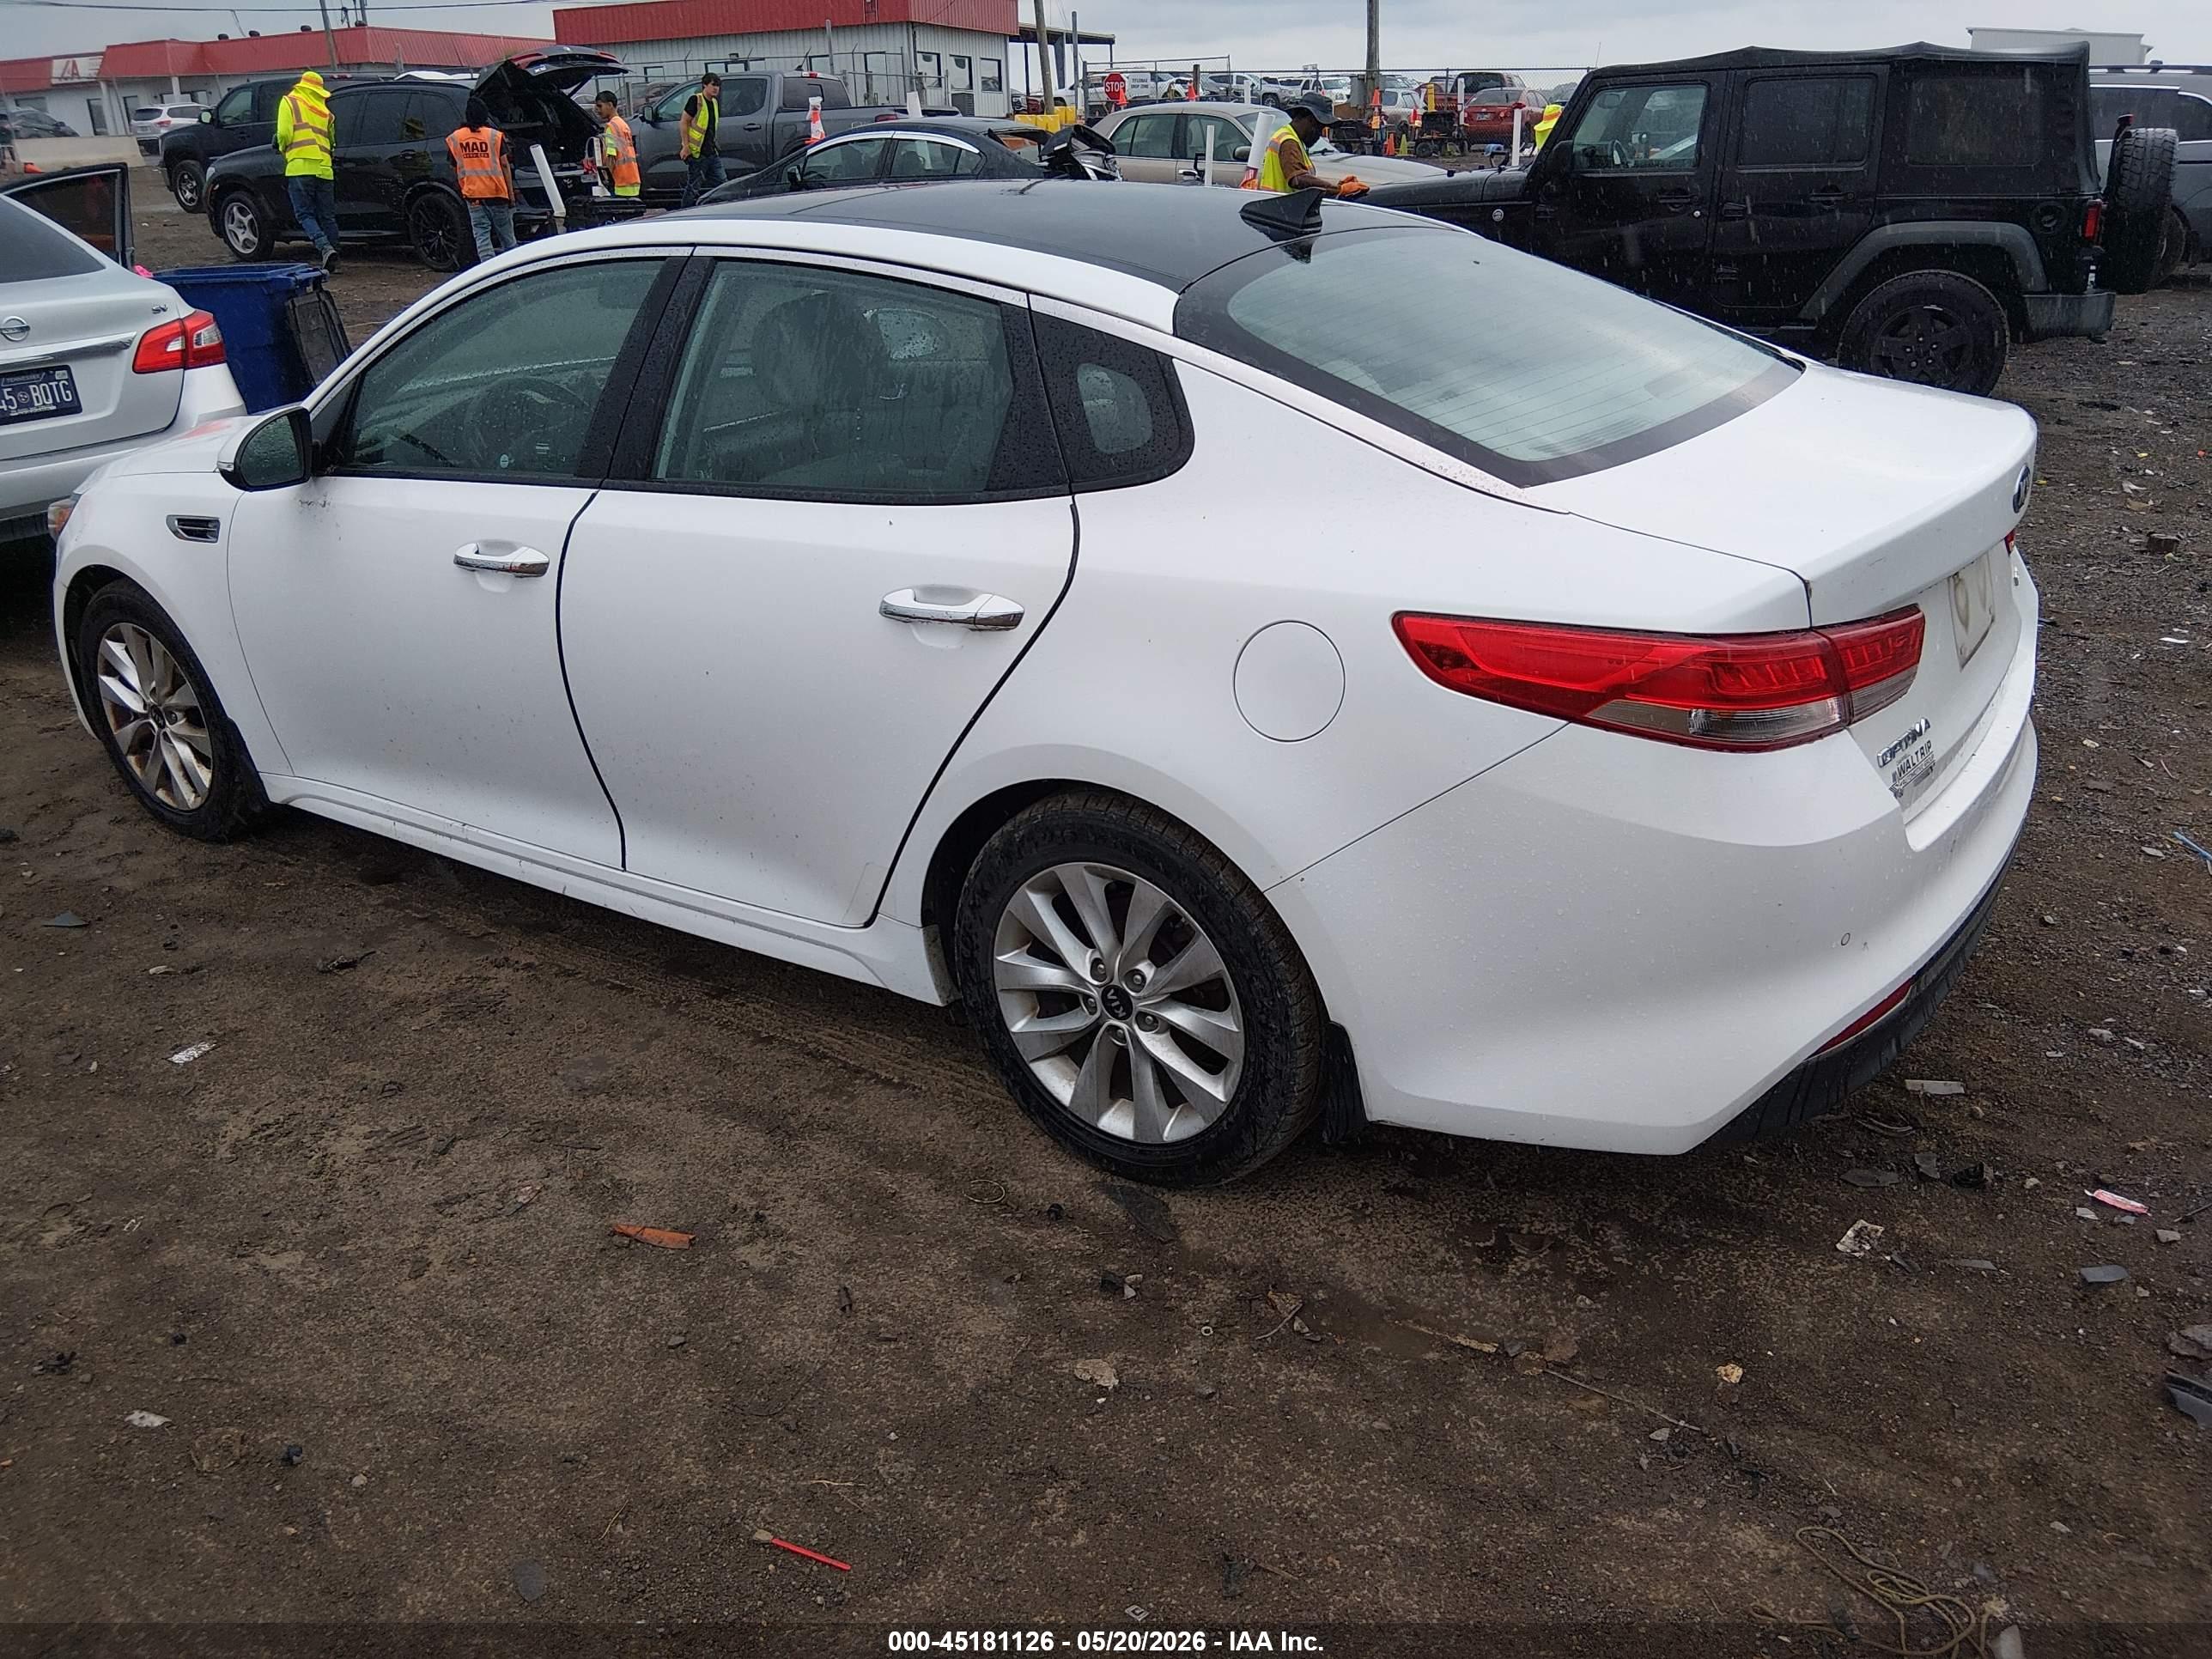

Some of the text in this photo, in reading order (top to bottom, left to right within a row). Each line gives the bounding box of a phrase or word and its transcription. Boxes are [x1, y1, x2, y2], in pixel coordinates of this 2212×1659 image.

[1105, 82, 1125, 92] STOP
[459, 141, 489, 153] MAD
[151, 304, 168, 314] SV
[1897, 739, 1932, 777] WALTRIP
